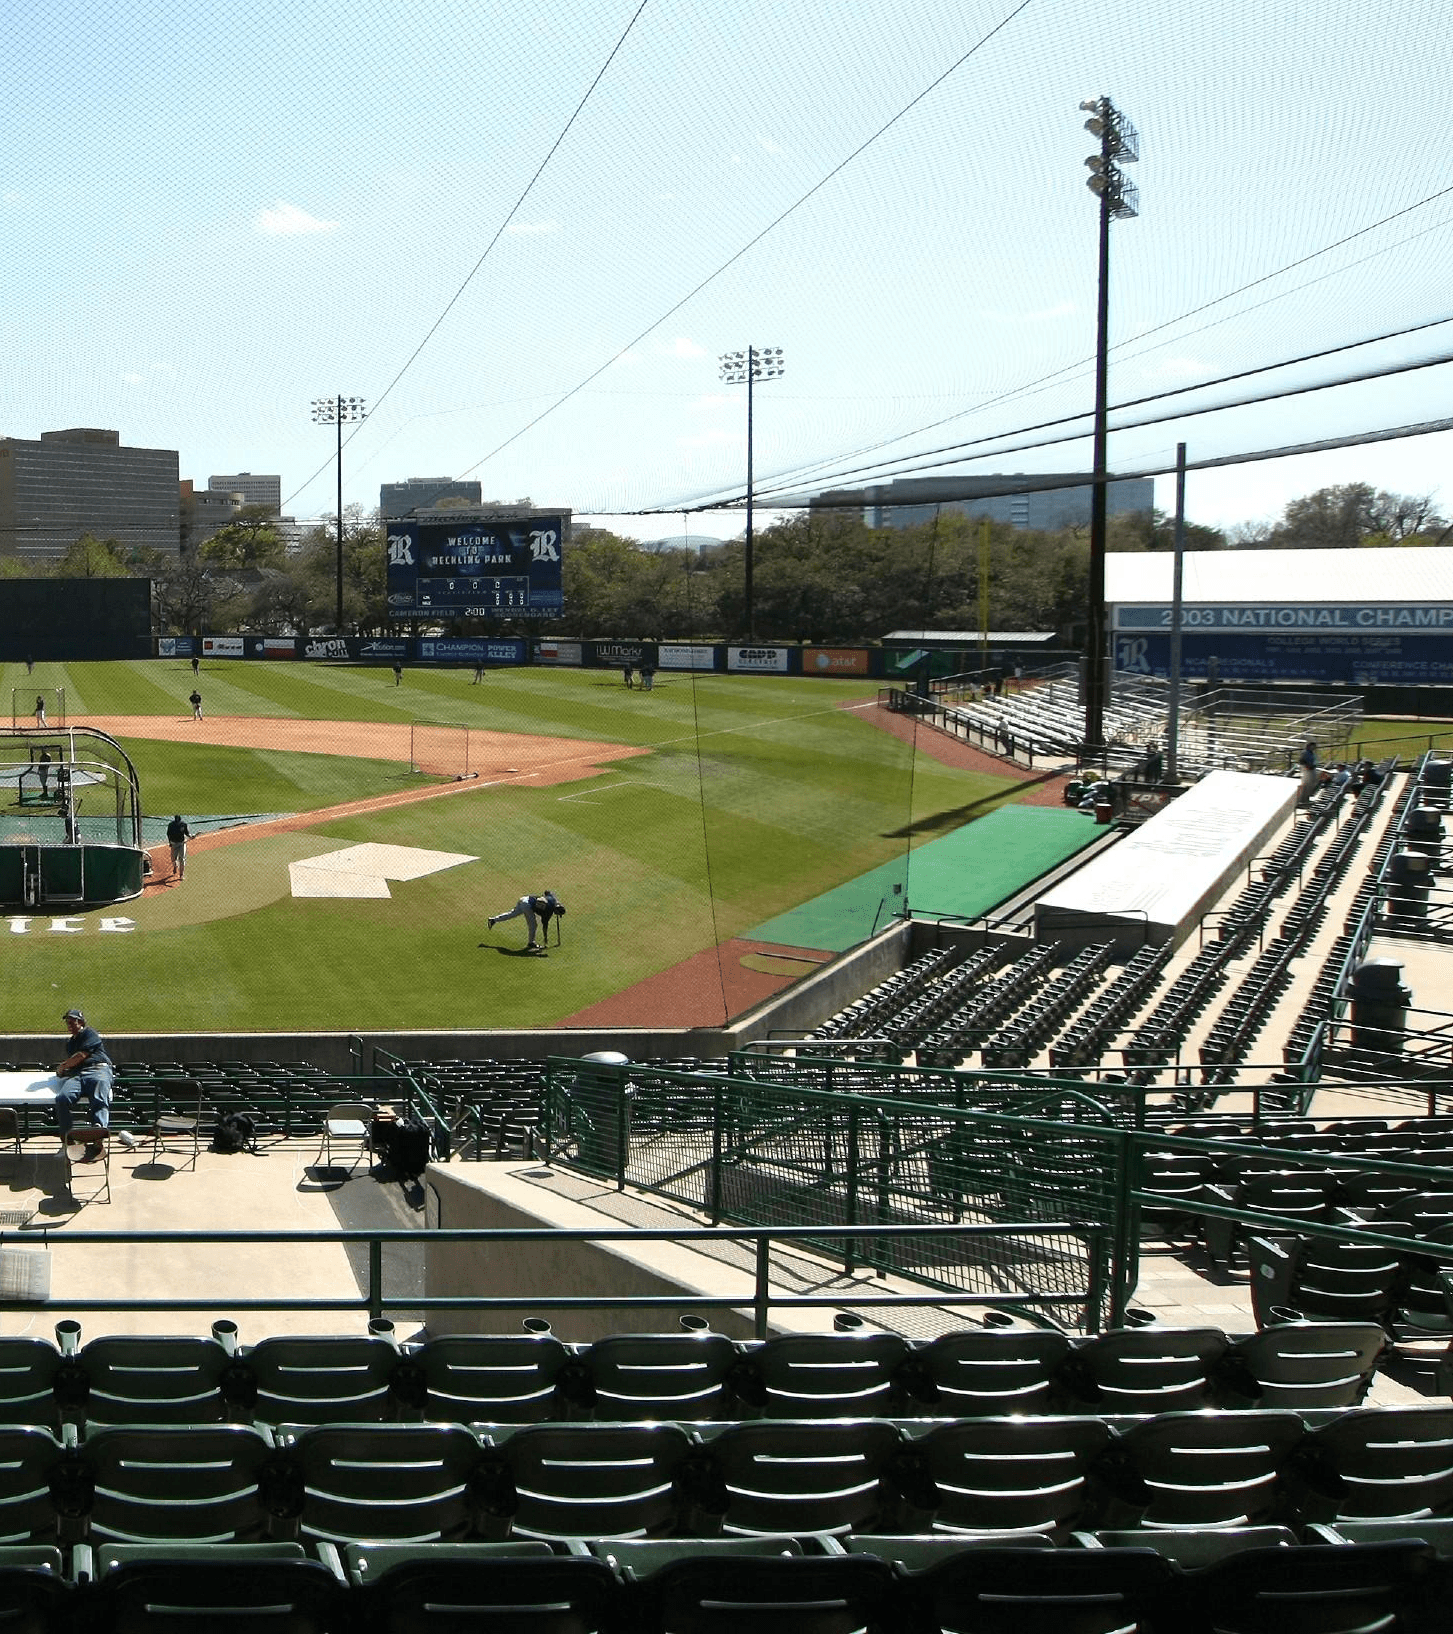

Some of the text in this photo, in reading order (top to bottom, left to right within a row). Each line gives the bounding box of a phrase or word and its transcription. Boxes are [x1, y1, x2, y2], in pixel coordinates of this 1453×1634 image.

[448, 536, 496, 547] WELCOME
[466, 545, 478, 555] TO
[484, 554, 512, 564] PARK
[431, 609, 456, 617] FIELD
[465, 607, 485, 617] 2:00
[1222, 609, 1348, 626] NATIONAL
[1356, 609, 1453, 626] CHAMP
[1267, 637, 1316, 645] COLLEGE
[1319, 637, 1359, 645] WORLD
[1352, 661, 1428, 669] CONFERENCE
